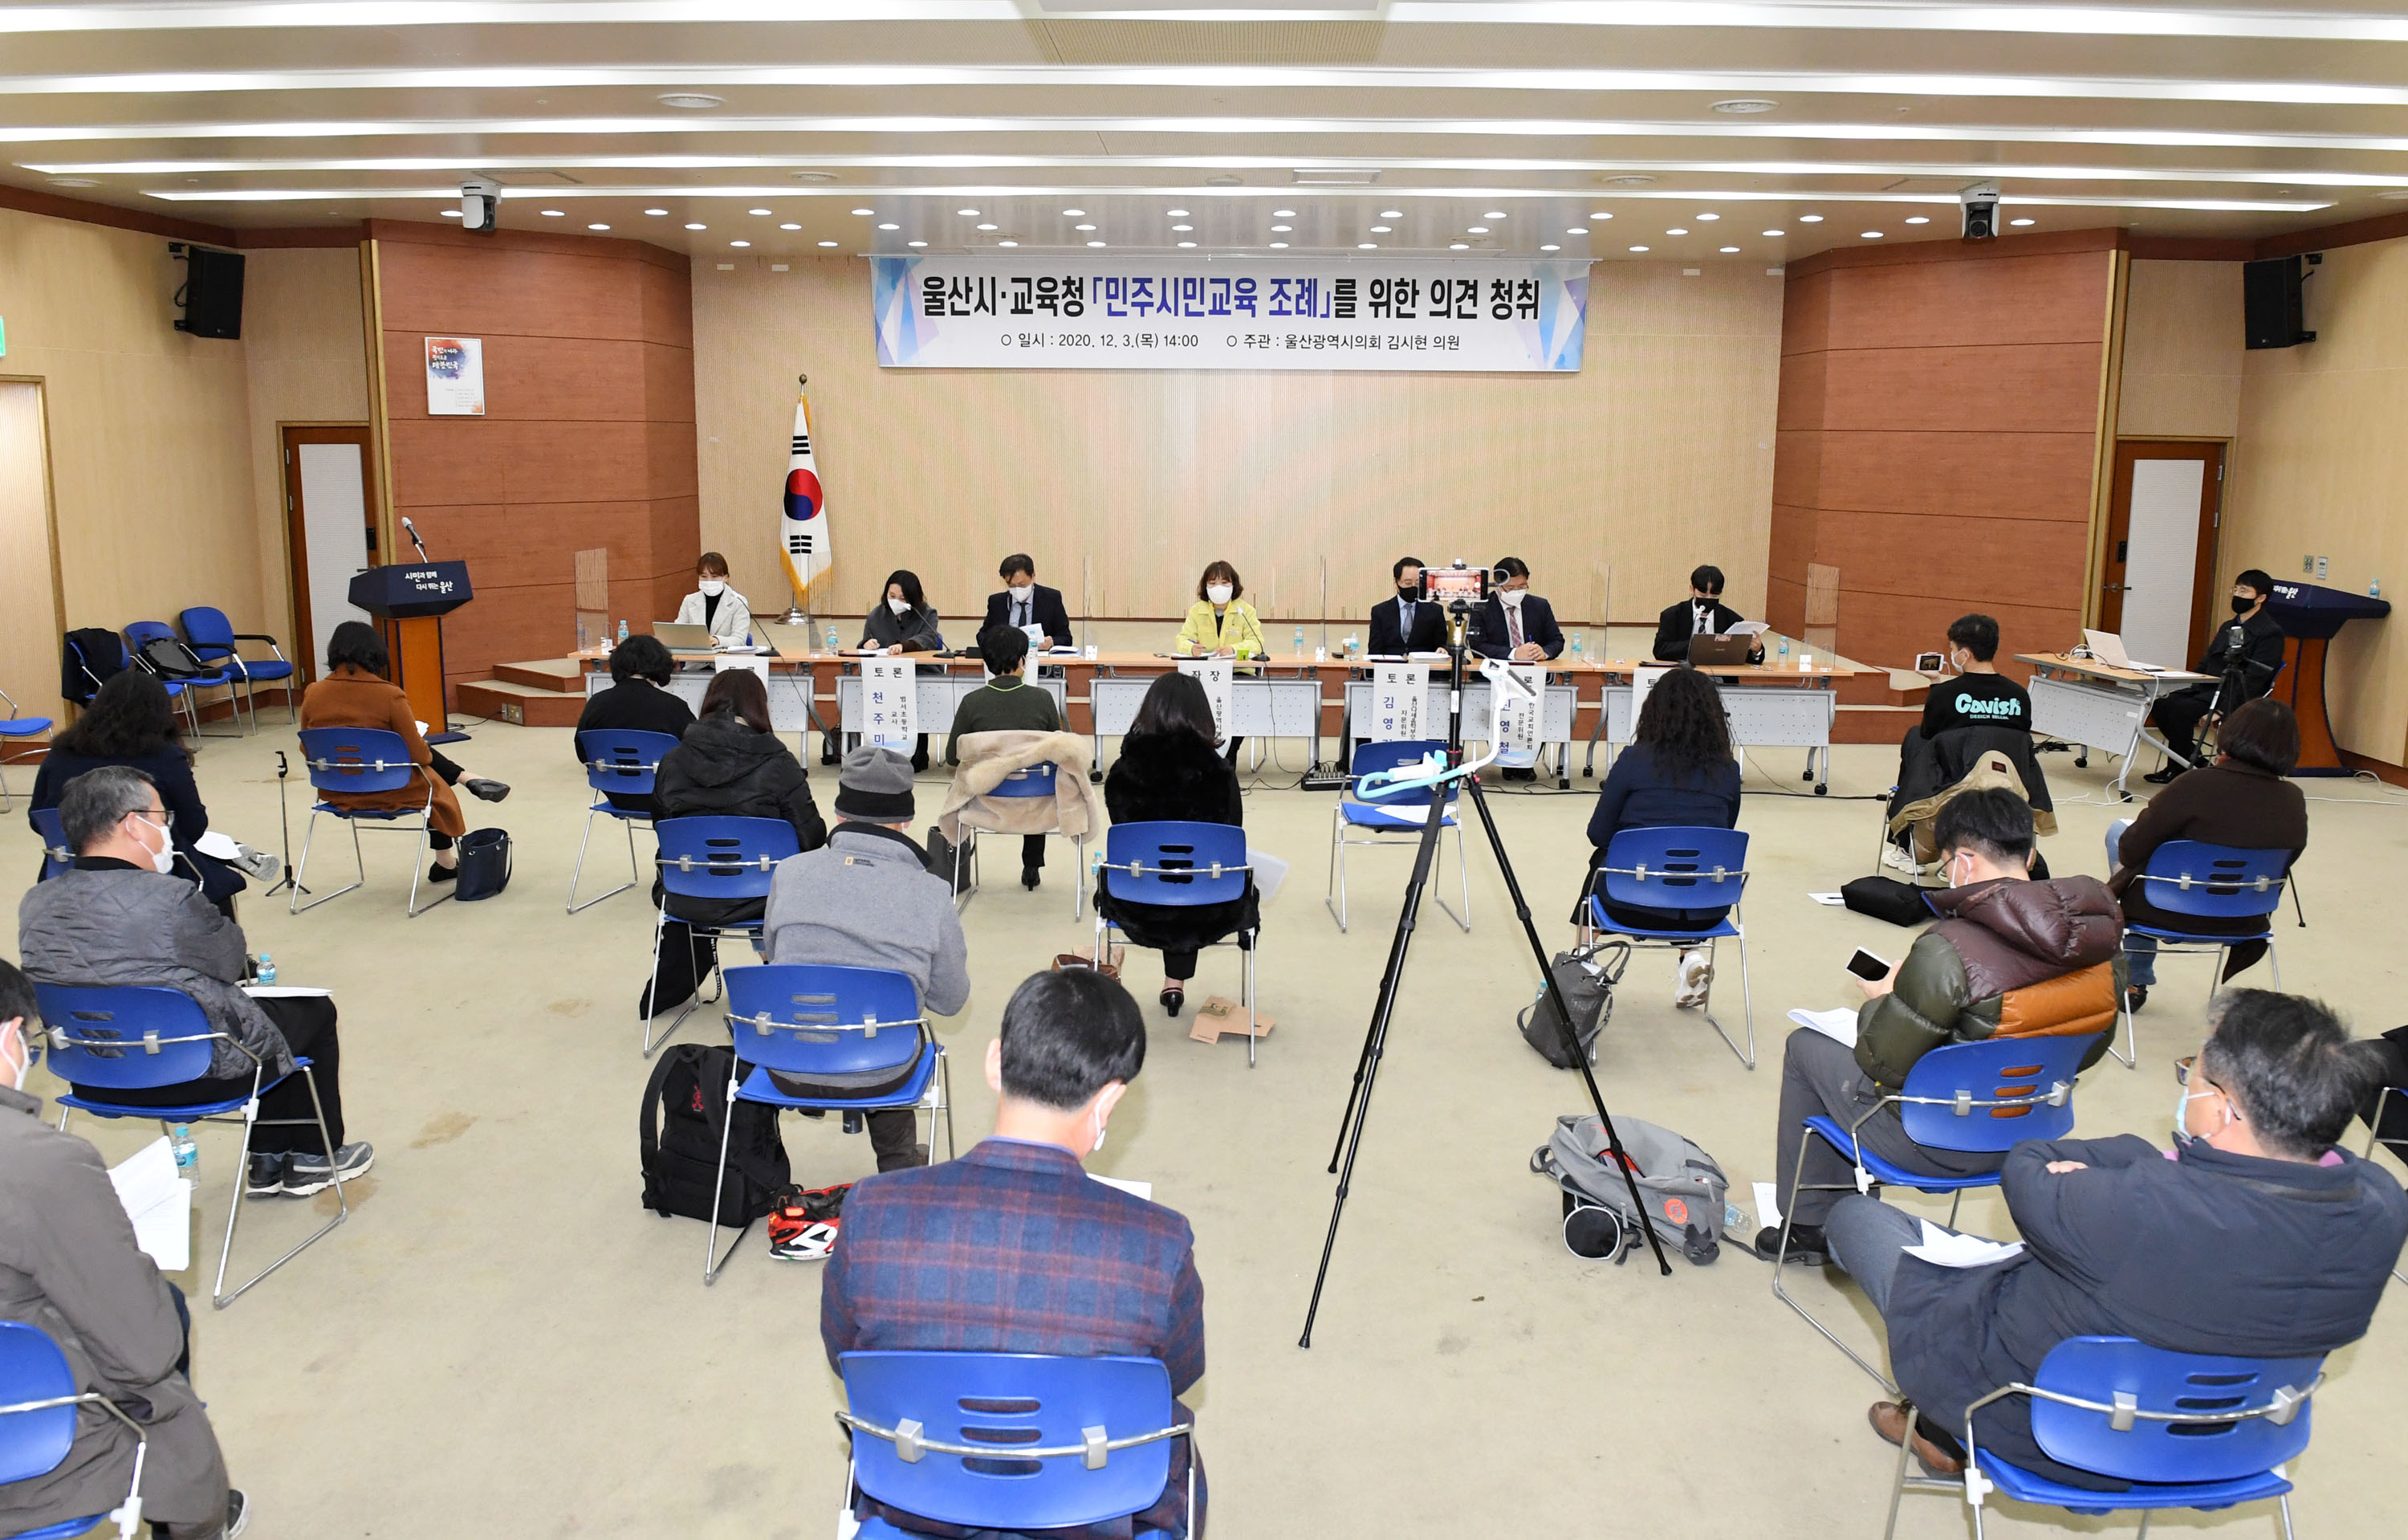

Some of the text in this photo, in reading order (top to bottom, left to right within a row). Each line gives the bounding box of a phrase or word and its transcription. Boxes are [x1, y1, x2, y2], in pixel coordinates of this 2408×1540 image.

[1268, 278, 1357, 319] 조례」를
[1369, 277, 1420, 319] 위한
[1429, 278, 1479, 320] 의견
[1490, 278, 1540, 320] 청취
[1018, 333, 1045, 348] 일시
[1059, 334, 1096, 348] 2020.
[1100, 334, 1118, 348] 12.
[1164, 334, 1199, 347] 14:00
[1243, 334, 1271, 350] 주관
[1284, 334, 1381, 351] 울산광역시의회
[1387, 334, 1428, 350] 김시현
[1433, 334, 1460, 351] 의원
[432, 361, 458, 370] 대한민국
[405, 572, 425, 583] 시민과
[439, 581, 454, 594] 울산
[1954, 693, 2022, 716] Cavish
